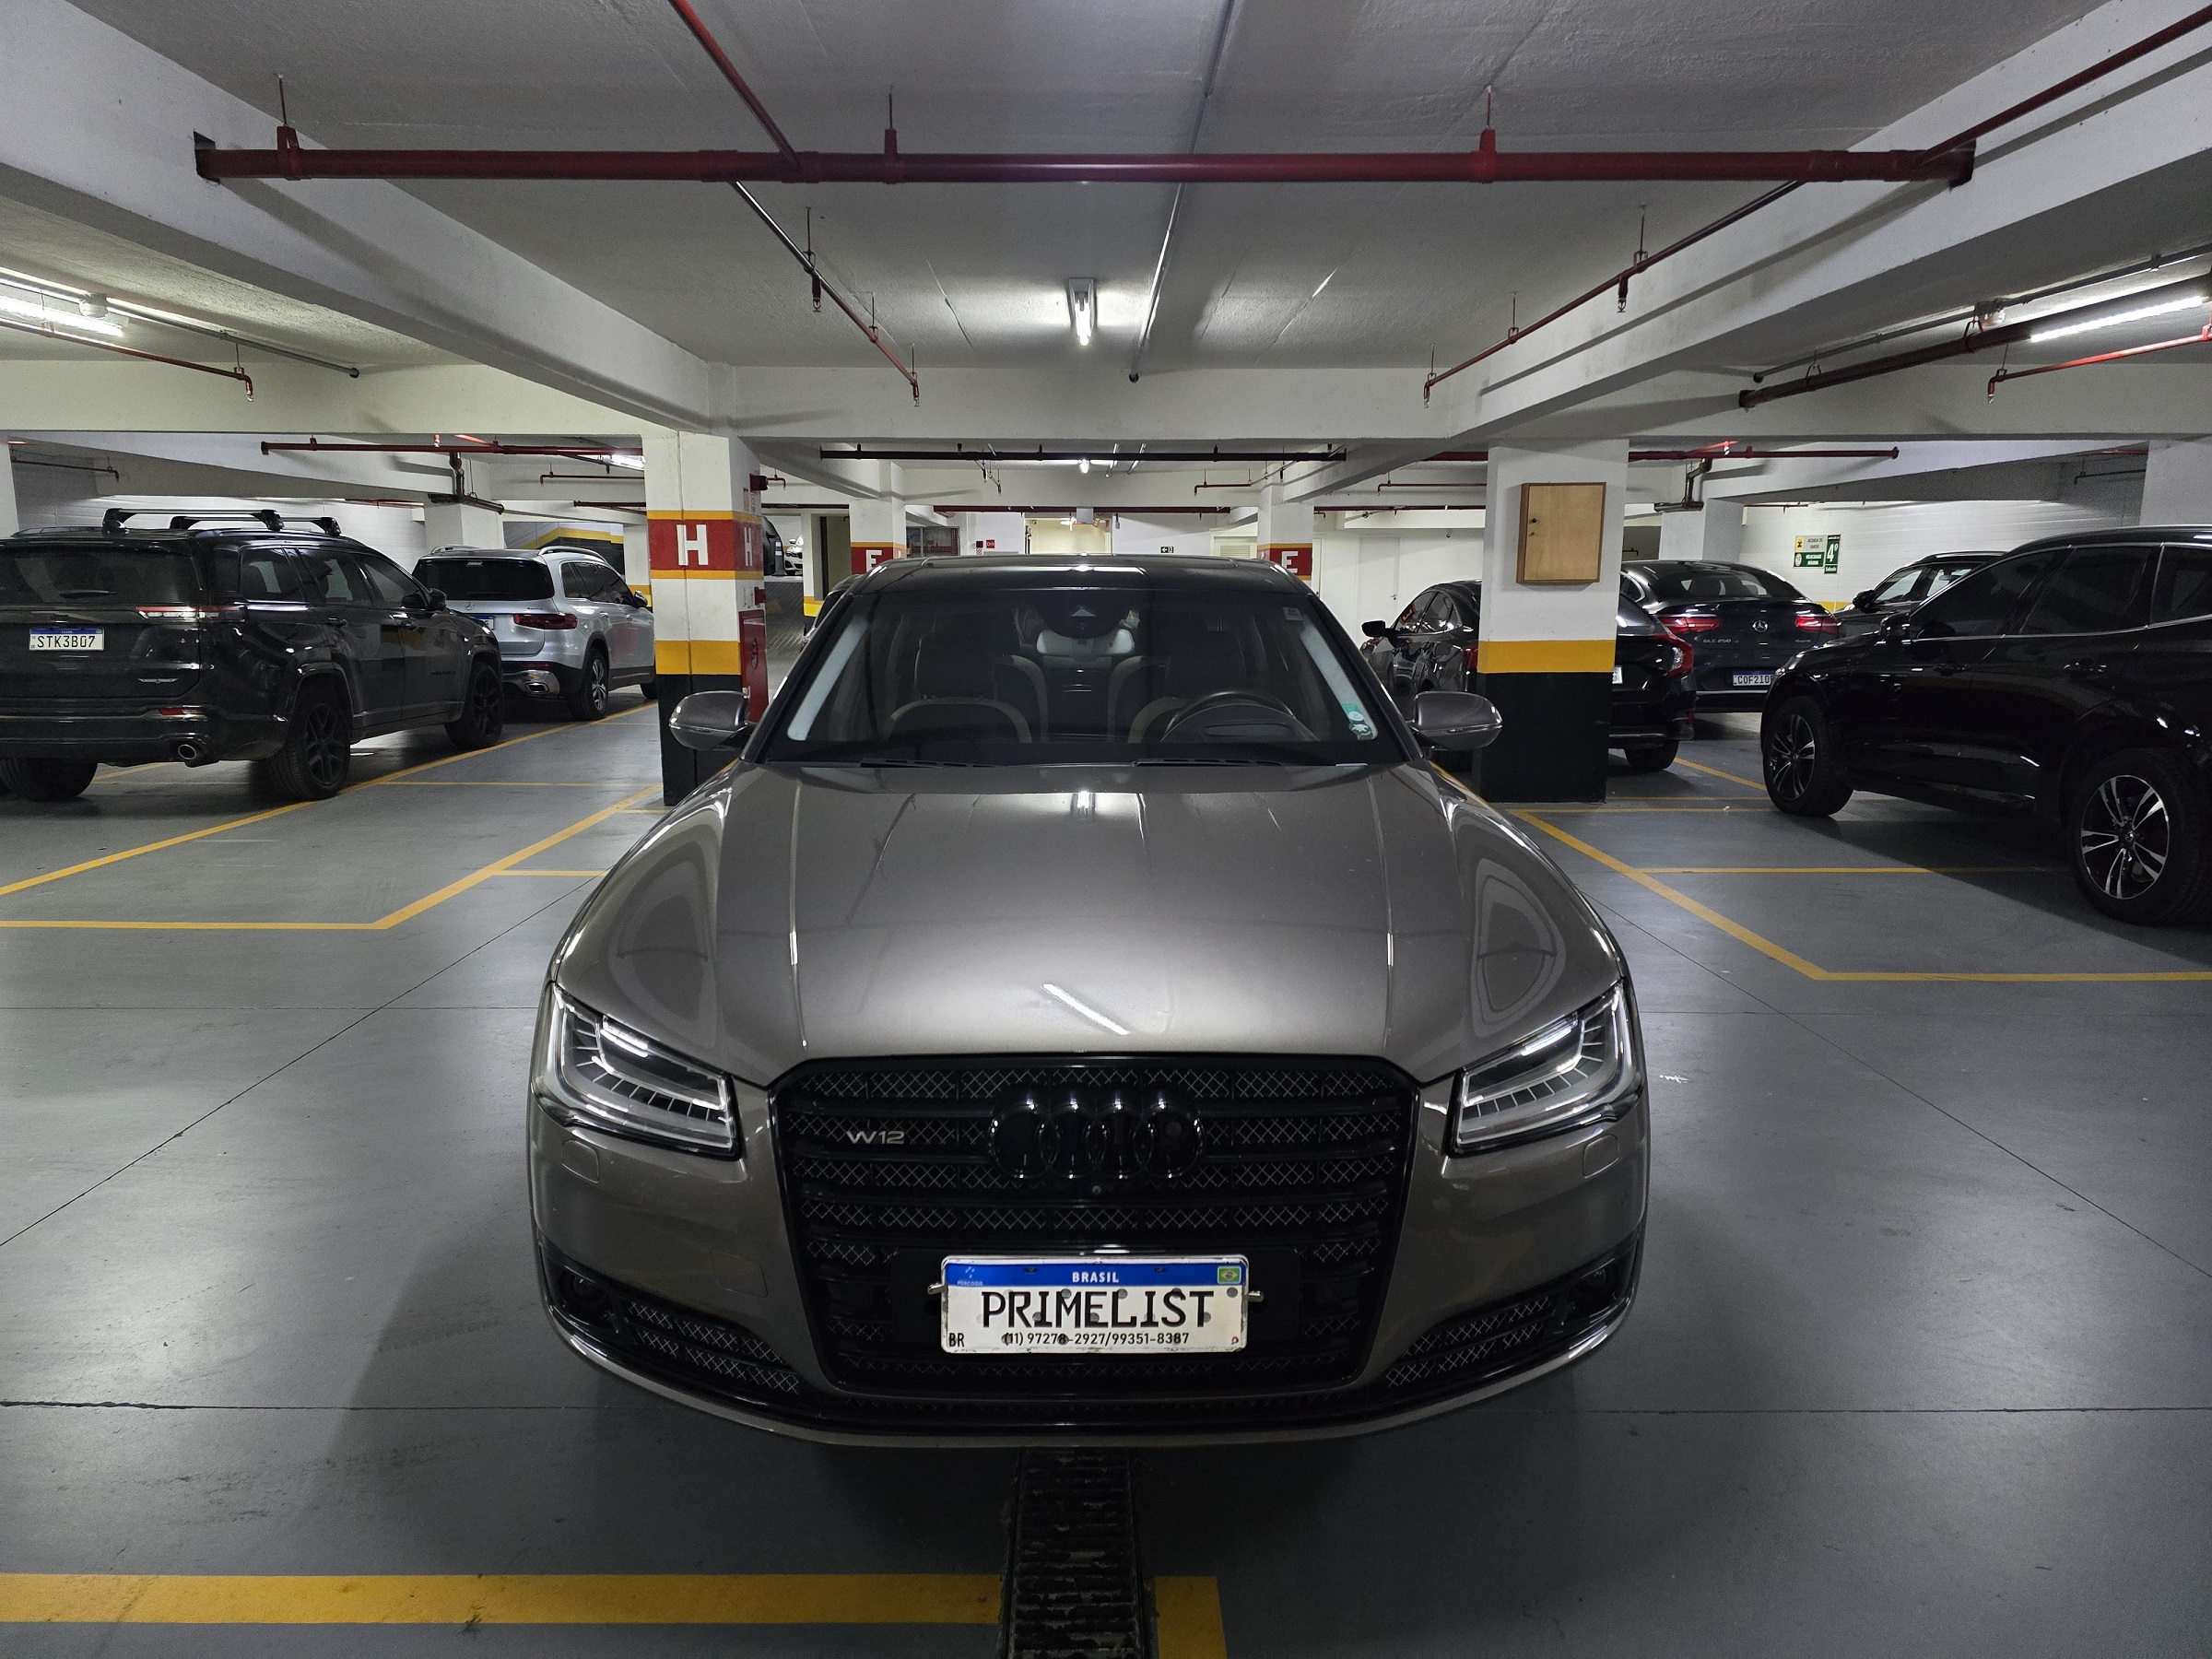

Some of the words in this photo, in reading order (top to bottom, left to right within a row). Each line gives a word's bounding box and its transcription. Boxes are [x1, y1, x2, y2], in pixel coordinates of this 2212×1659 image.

[677, 524, 709, 566] H
[744, 526, 753, 567] H
[1282, 550, 1299, 573] E
[37, 635, 95, 648] STK3B07
[846, 1130, 905, 1144] W12
[1072, 1271, 1120, 1283] BRASIL
[981, 1290, 1215, 1328] PRIMELIST
[948, 1333, 965, 1347] BR
[1005, 1332, 1024, 1347] (11)
